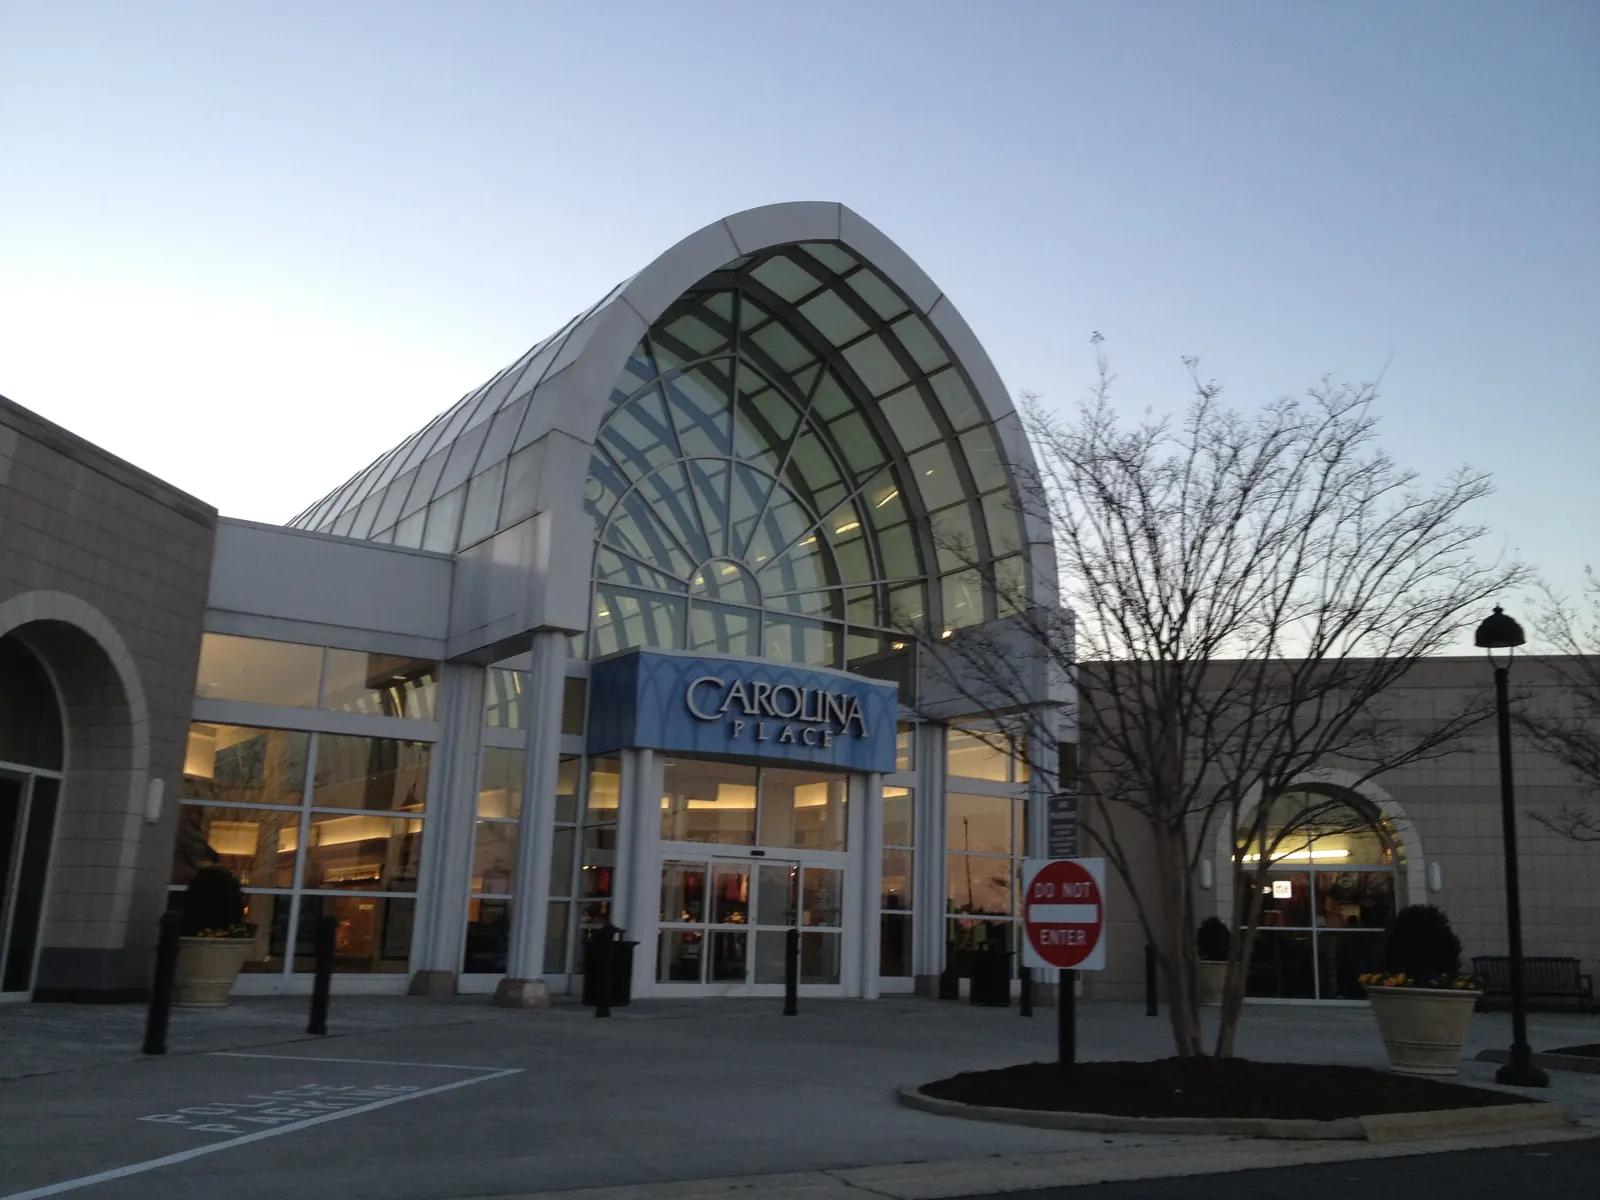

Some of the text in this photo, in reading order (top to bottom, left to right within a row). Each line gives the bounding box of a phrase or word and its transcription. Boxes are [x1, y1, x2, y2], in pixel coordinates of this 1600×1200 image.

[686, 676, 868, 737] CAROLINA
[732, 720, 833, 748] PLACE
[1034, 882, 1092, 898] DO NOT
[1040, 928, 1087, 946] ENTER
[136, 1083, 356, 1124] POLICE
[187, 1083, 422, 1134] PARKING
